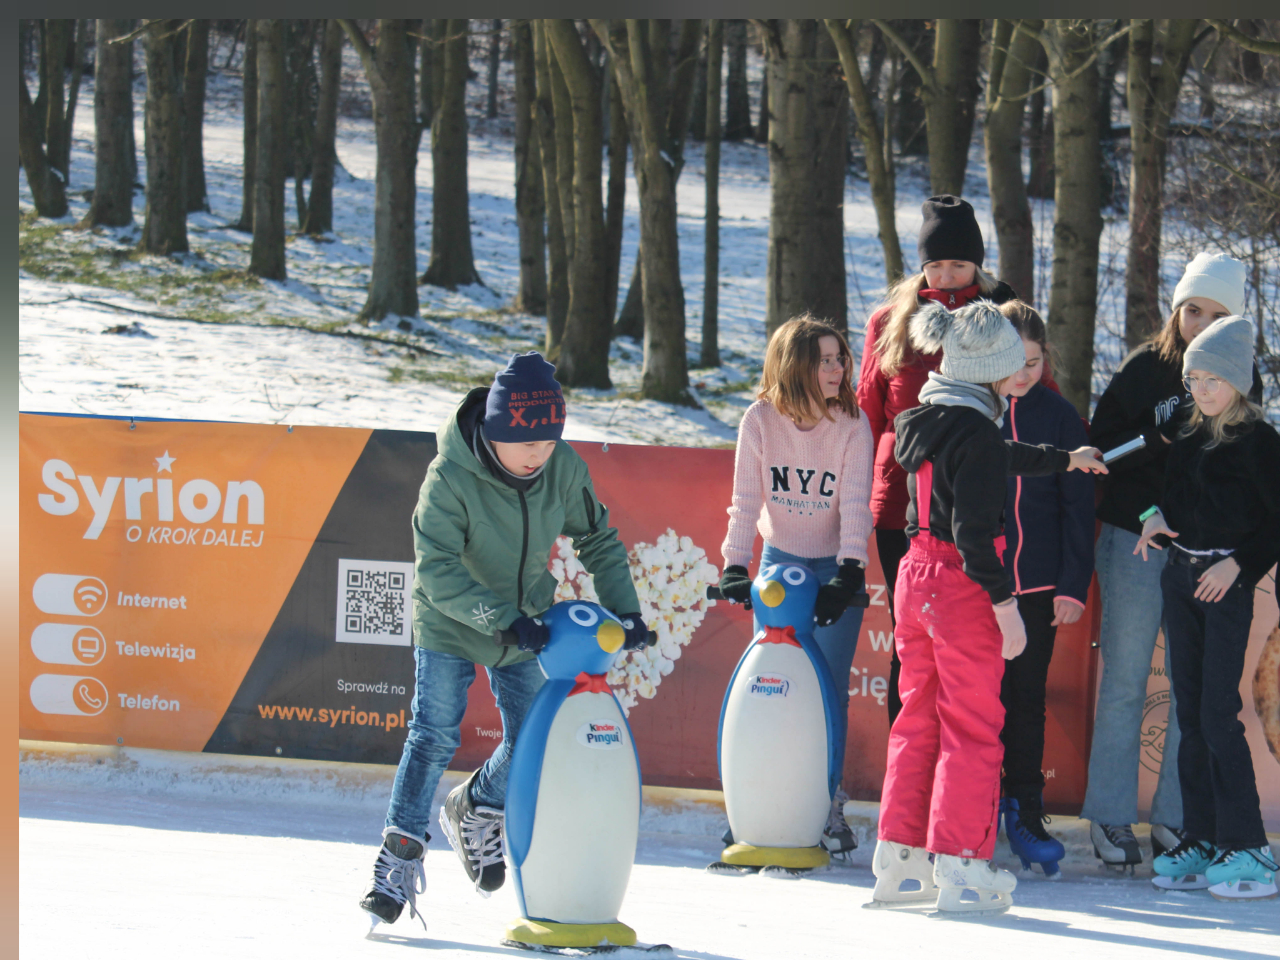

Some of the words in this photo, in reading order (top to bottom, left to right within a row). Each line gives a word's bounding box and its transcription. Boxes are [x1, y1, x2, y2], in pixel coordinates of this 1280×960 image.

[511, 392, 528, 400] BIG
[532, 390, 555, 399] STAR
[771, 466, 836, 497] NYC
[38, 450, 265, 540] Syrion
[771, 495, 830, 509] MANHATTAN
[126, 526, 142, 542] O
[147, 527, 200, 545] KROK
[201, 530, 264, 547] DALEJ
[117, 591, 187, 610] Internet
[116, 641, 196, 662] Telewizja
[337, 679, 388, 695] Sprawdź
[391, 684, 406, 695] na
[118, 693, 180, 712] Telefon
[258, 704, 405, 731] www.syrion.pl
[476, 727, 501, 738] Twoje
